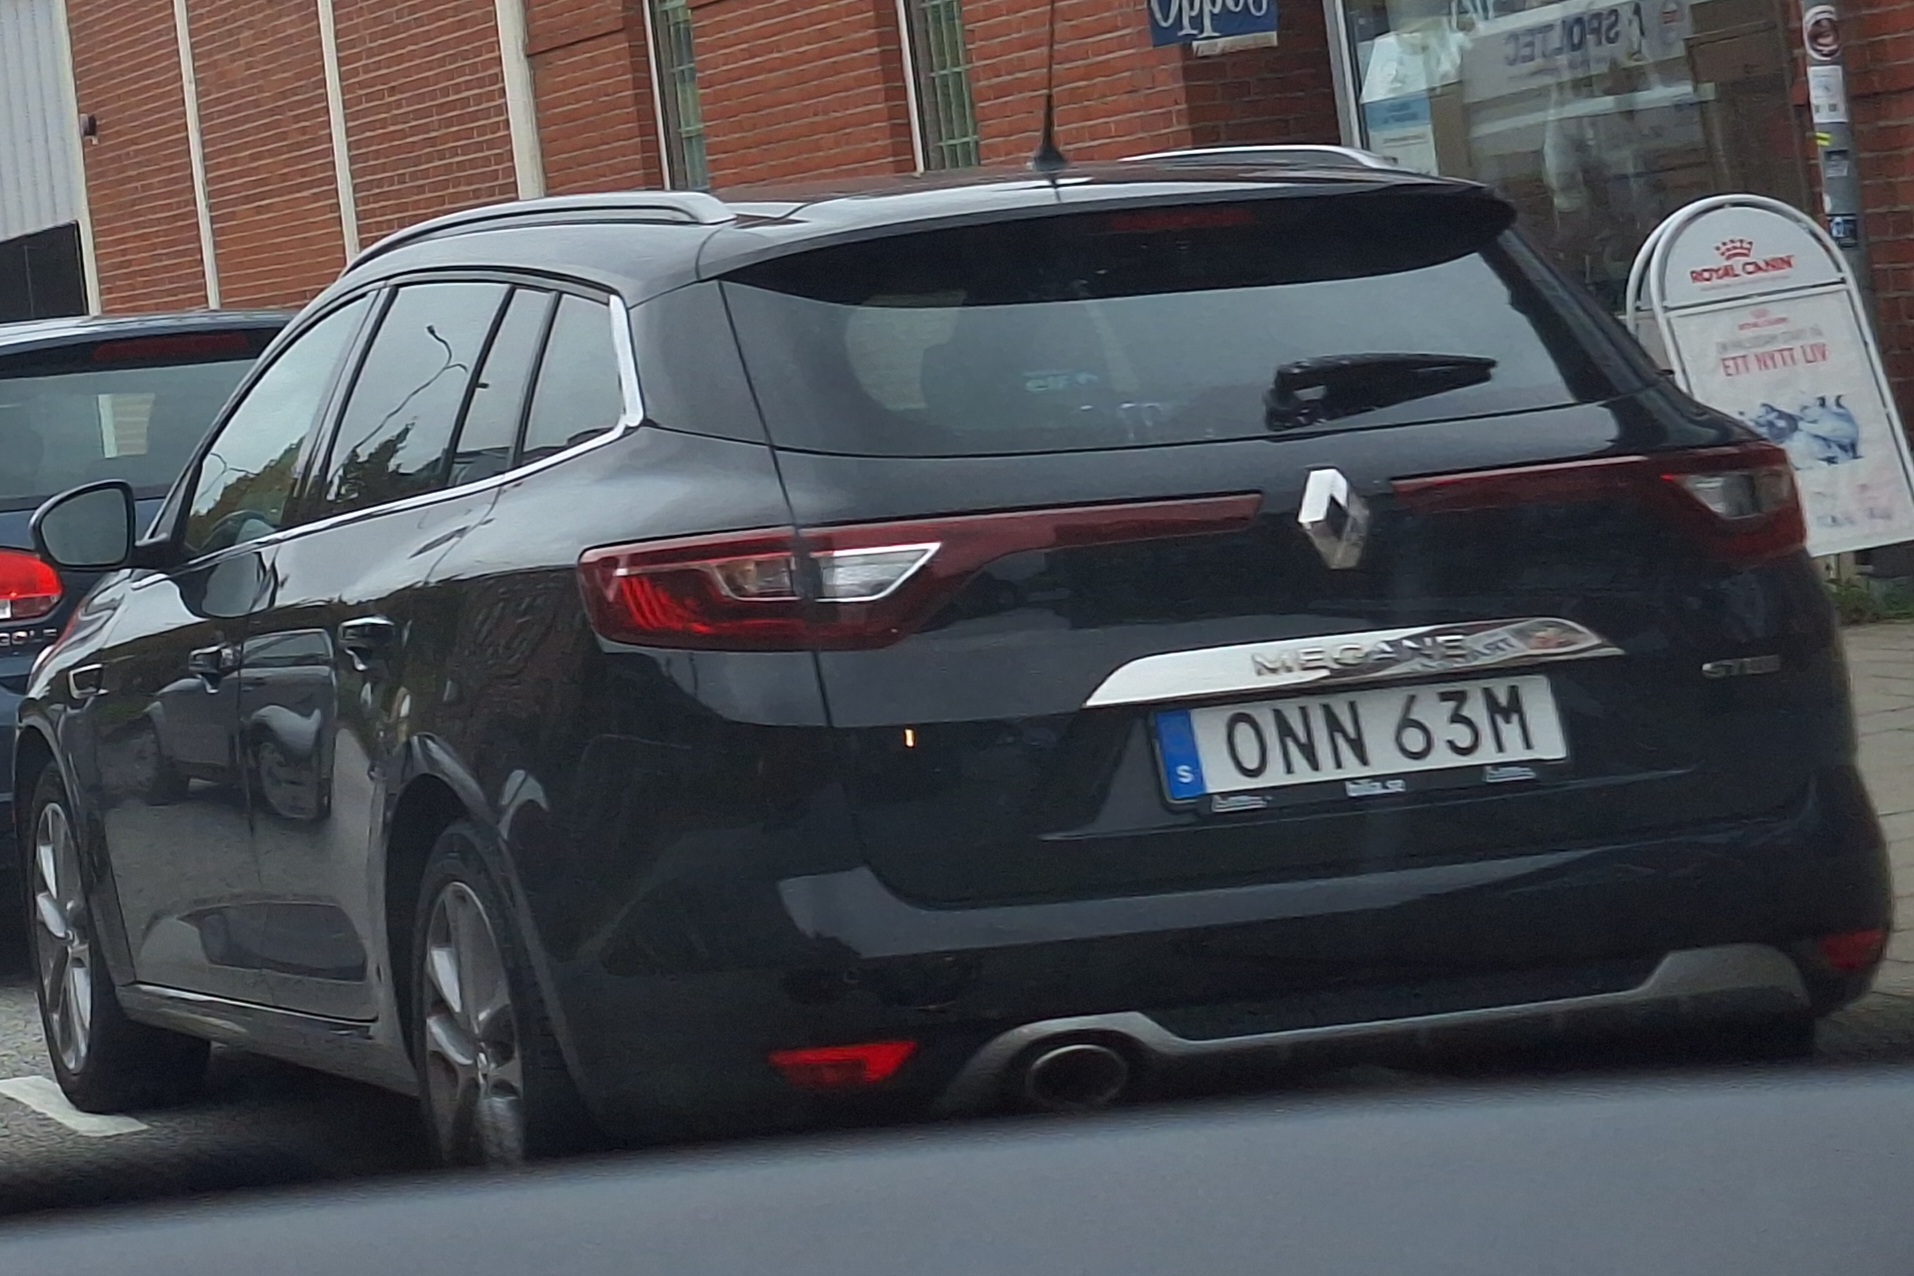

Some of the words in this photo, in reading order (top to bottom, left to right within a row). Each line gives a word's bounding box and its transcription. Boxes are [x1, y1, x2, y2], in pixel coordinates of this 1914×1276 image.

[1689, 264, 1741, 283] ROYAL
[1742, 254, 1794, 275] CANIN
[1721, 354, 1749, 377] ETT
[1755, 347, 1797, 371] NYTT
[1226, 700, 1370, 779] ONN
[1395, 684, 1535, 761] 63M
[1176, 765, 1194, 783] S
